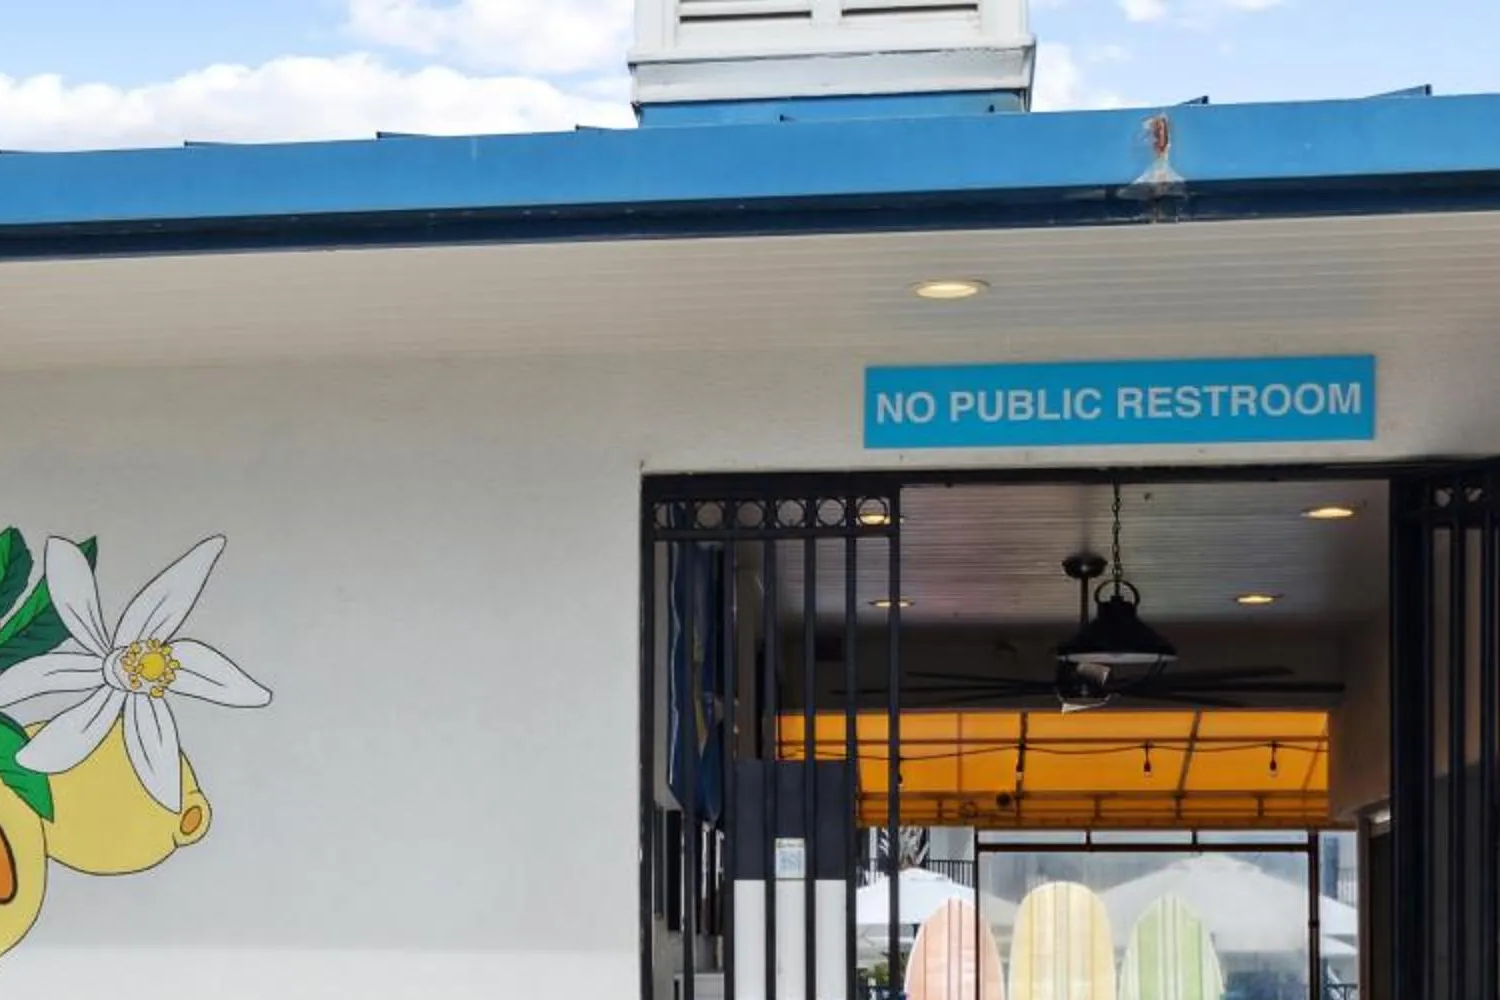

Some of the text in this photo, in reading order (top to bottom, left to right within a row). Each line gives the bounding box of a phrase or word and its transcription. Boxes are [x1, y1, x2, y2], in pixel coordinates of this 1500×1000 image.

[876, 383, 1362, 424] NO PUBLIC RESTROOM
